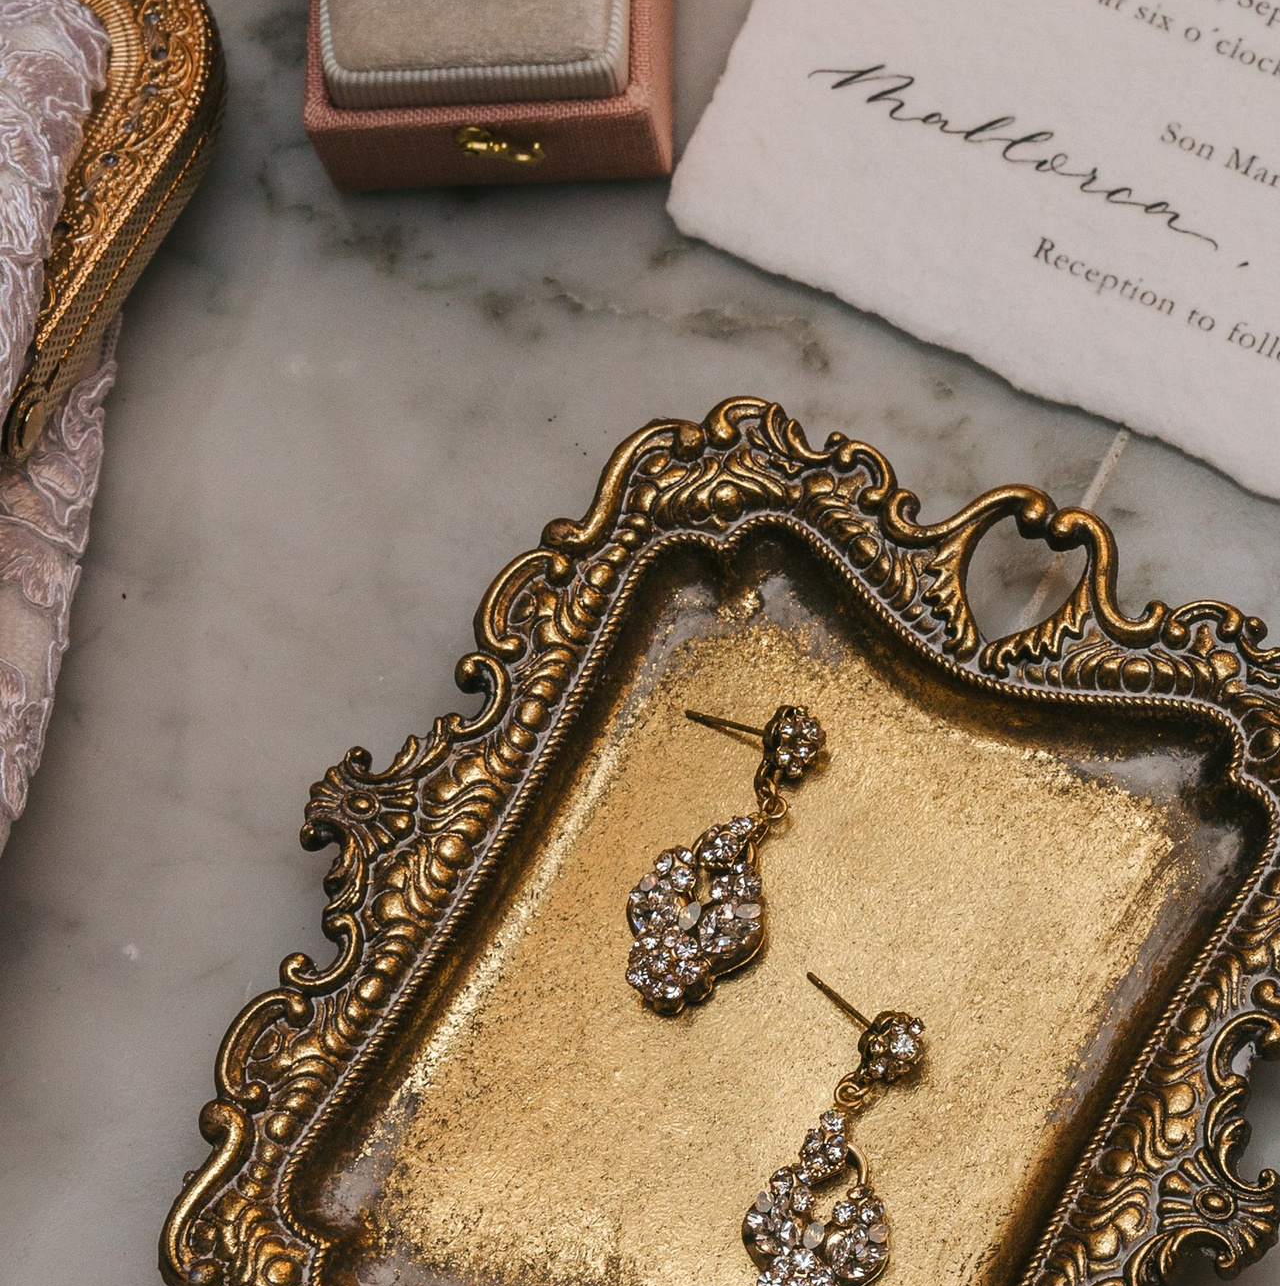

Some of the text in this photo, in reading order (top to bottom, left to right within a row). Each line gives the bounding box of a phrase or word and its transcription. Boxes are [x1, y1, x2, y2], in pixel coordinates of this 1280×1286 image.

[1133, 4, 1174, 32] six
[1160, 121, 1215, 161] Son
[1032, 236, 1175, 316] Reception
[1187, 308, 1216, 334] to
